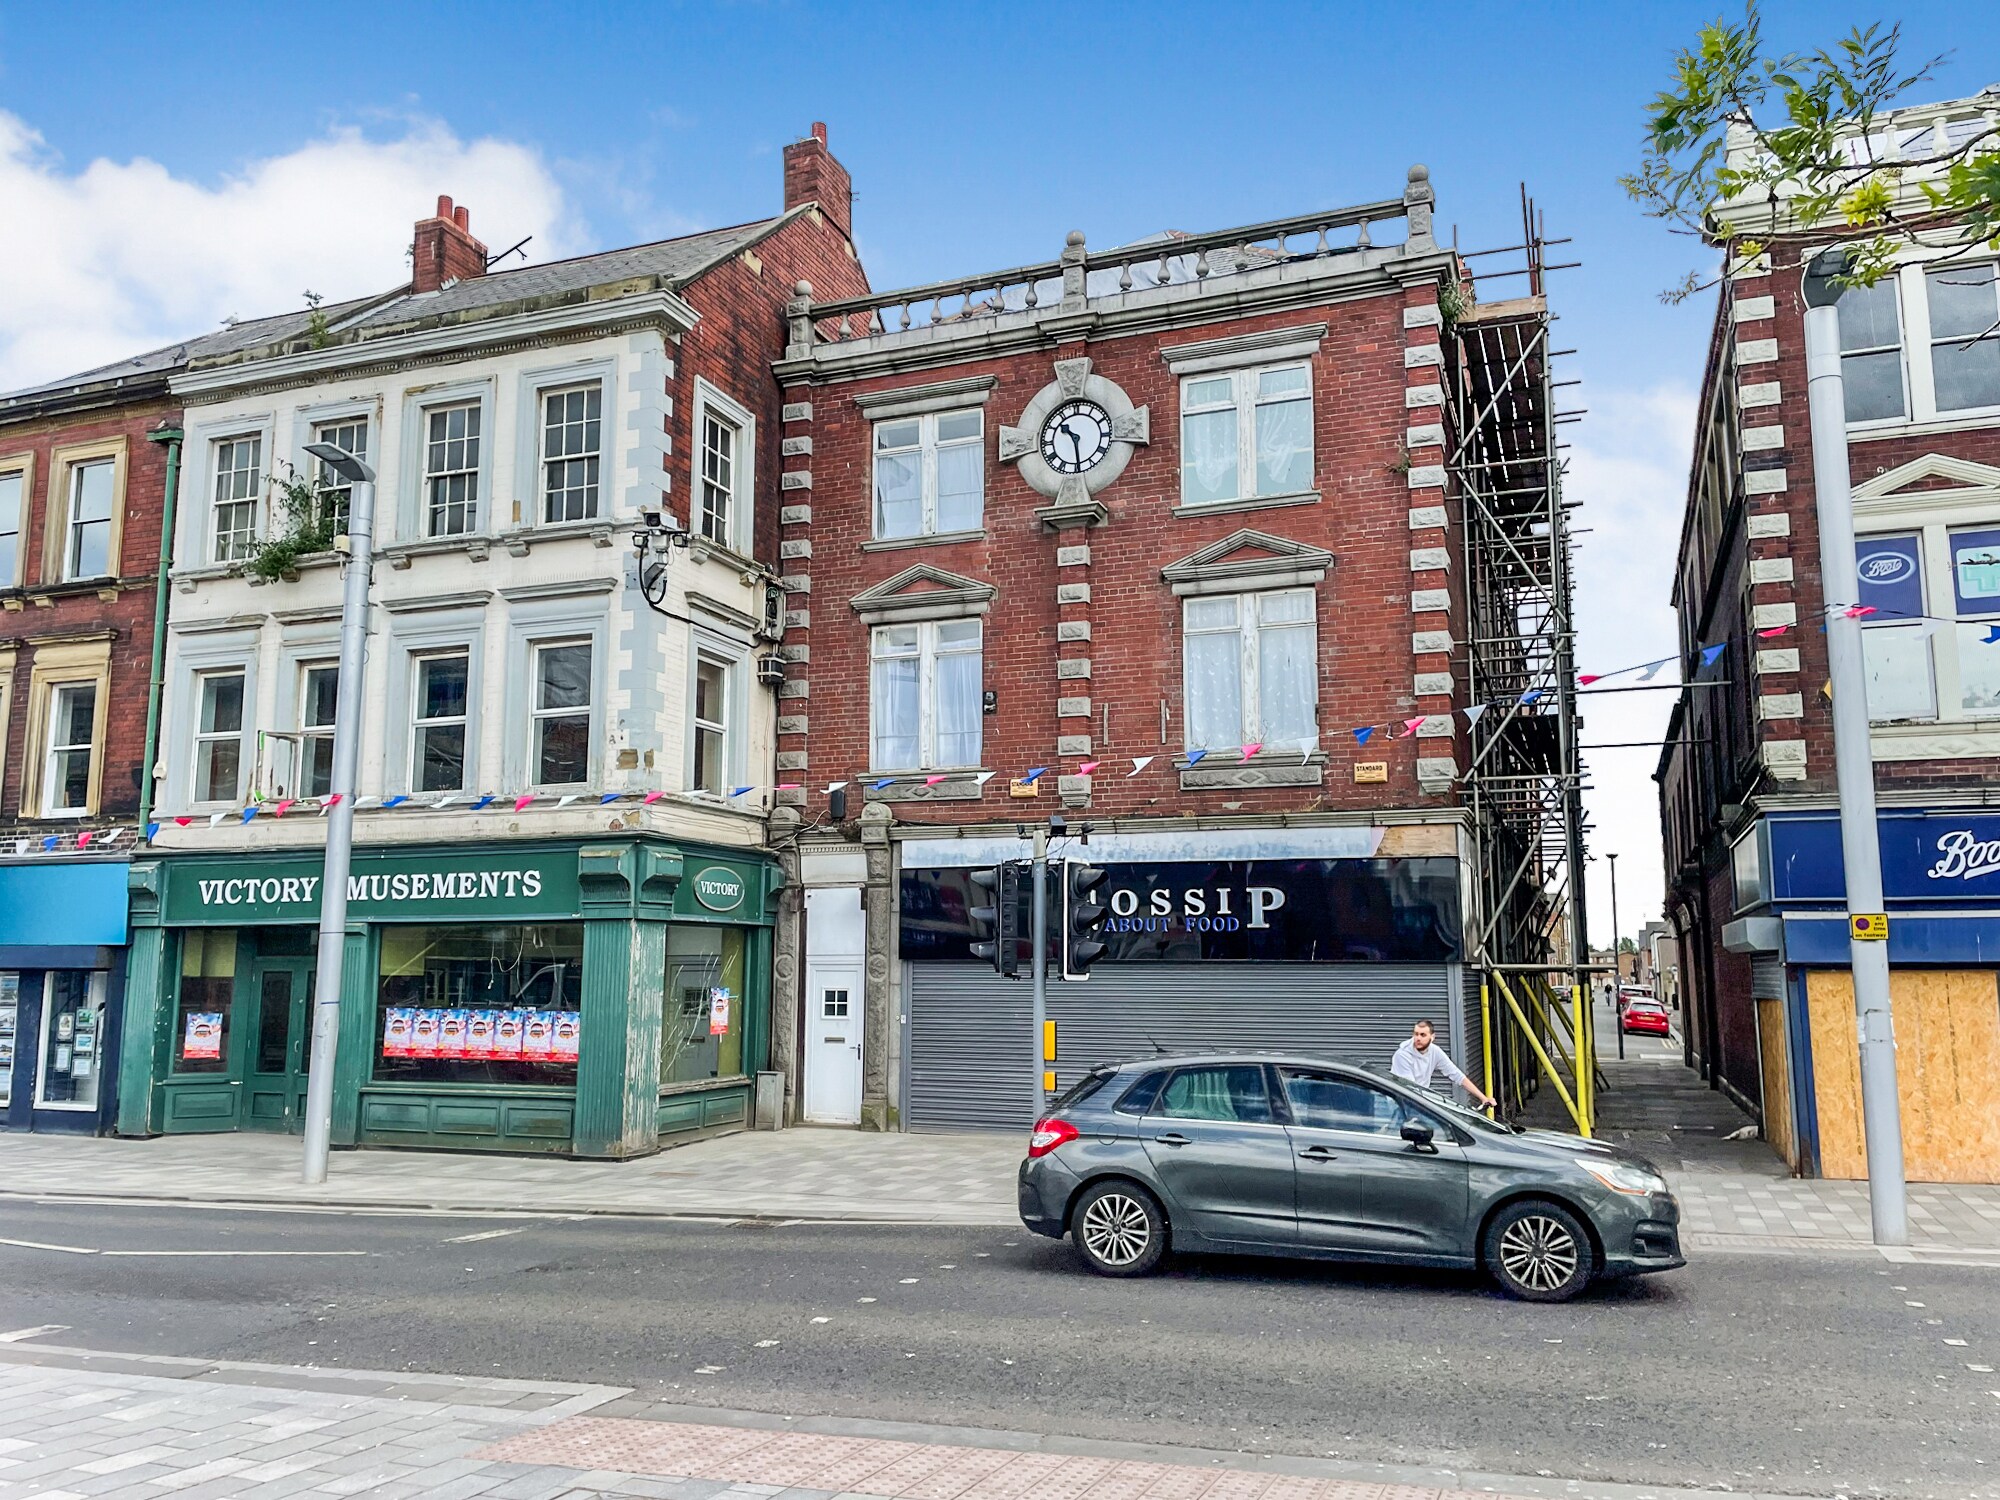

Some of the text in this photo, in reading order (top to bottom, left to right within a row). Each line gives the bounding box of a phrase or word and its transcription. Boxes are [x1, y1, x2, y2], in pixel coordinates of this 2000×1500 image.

[1865, 558, 1902, 577] Boots
[198, 869, 543, 905] VICTORY MUSEMENTS
[700, 881, 739, 896] VICTORY
[1104, 916, 1240, 933] ABOUT FOOD
